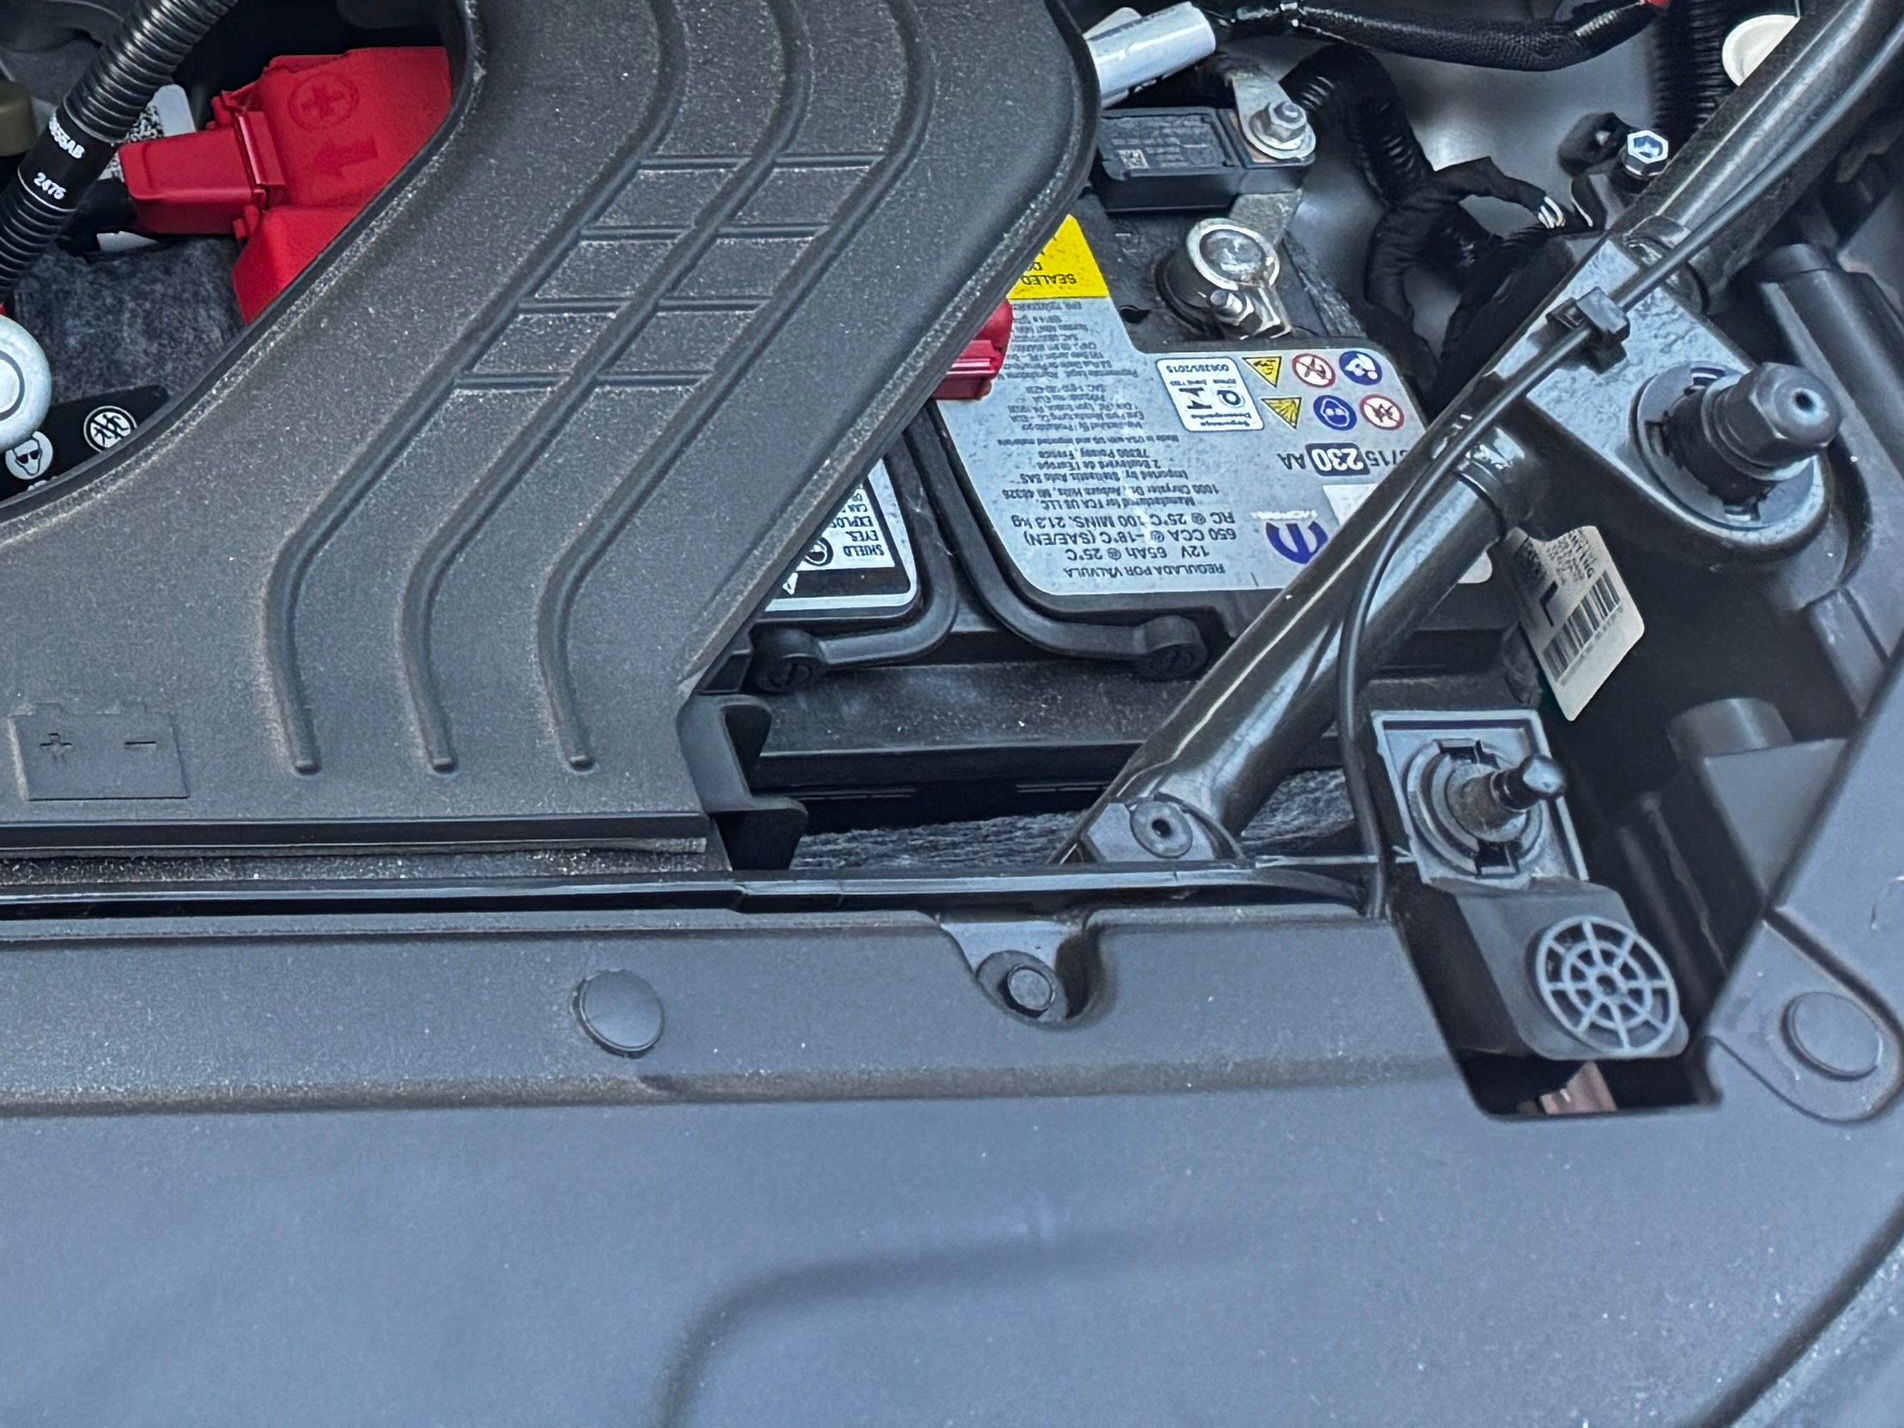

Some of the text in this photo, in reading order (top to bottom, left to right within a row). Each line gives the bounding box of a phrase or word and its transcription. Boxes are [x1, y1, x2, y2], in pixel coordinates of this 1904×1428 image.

[1020, 273, 1077, 286] SEALED
[1277, 452, 1306, 471] AA
[1309, 446, 1363, 472] 230
[1146, 482, 1191, 496] Chrysler
[1063, 499, 1080, 510] US
[1105, 498, 1121, 509] for
[1011, 514, 1030, 530] kg
[1117, 514, 1144, 528] 100
[1149, 512, 1187, 526] 25°C
[1190, 512, 1207, 526] @
[1210, 511, 1235, 525] RC
[1023, 529, 1096, 546] (SAE/EN)
[1150, 530, 1165, 544] @
[1167, 529, 1205, 543] CCA
[1207, 528, 1237, 542] 650
[842, 544, 884, 557] SHIELD
[1064, 545, 1210, 562] 12V 65Ah @ 25°C
[1123, 565, 1152, 577] POR
[1154, 564, 1226, 577] REGULADA
